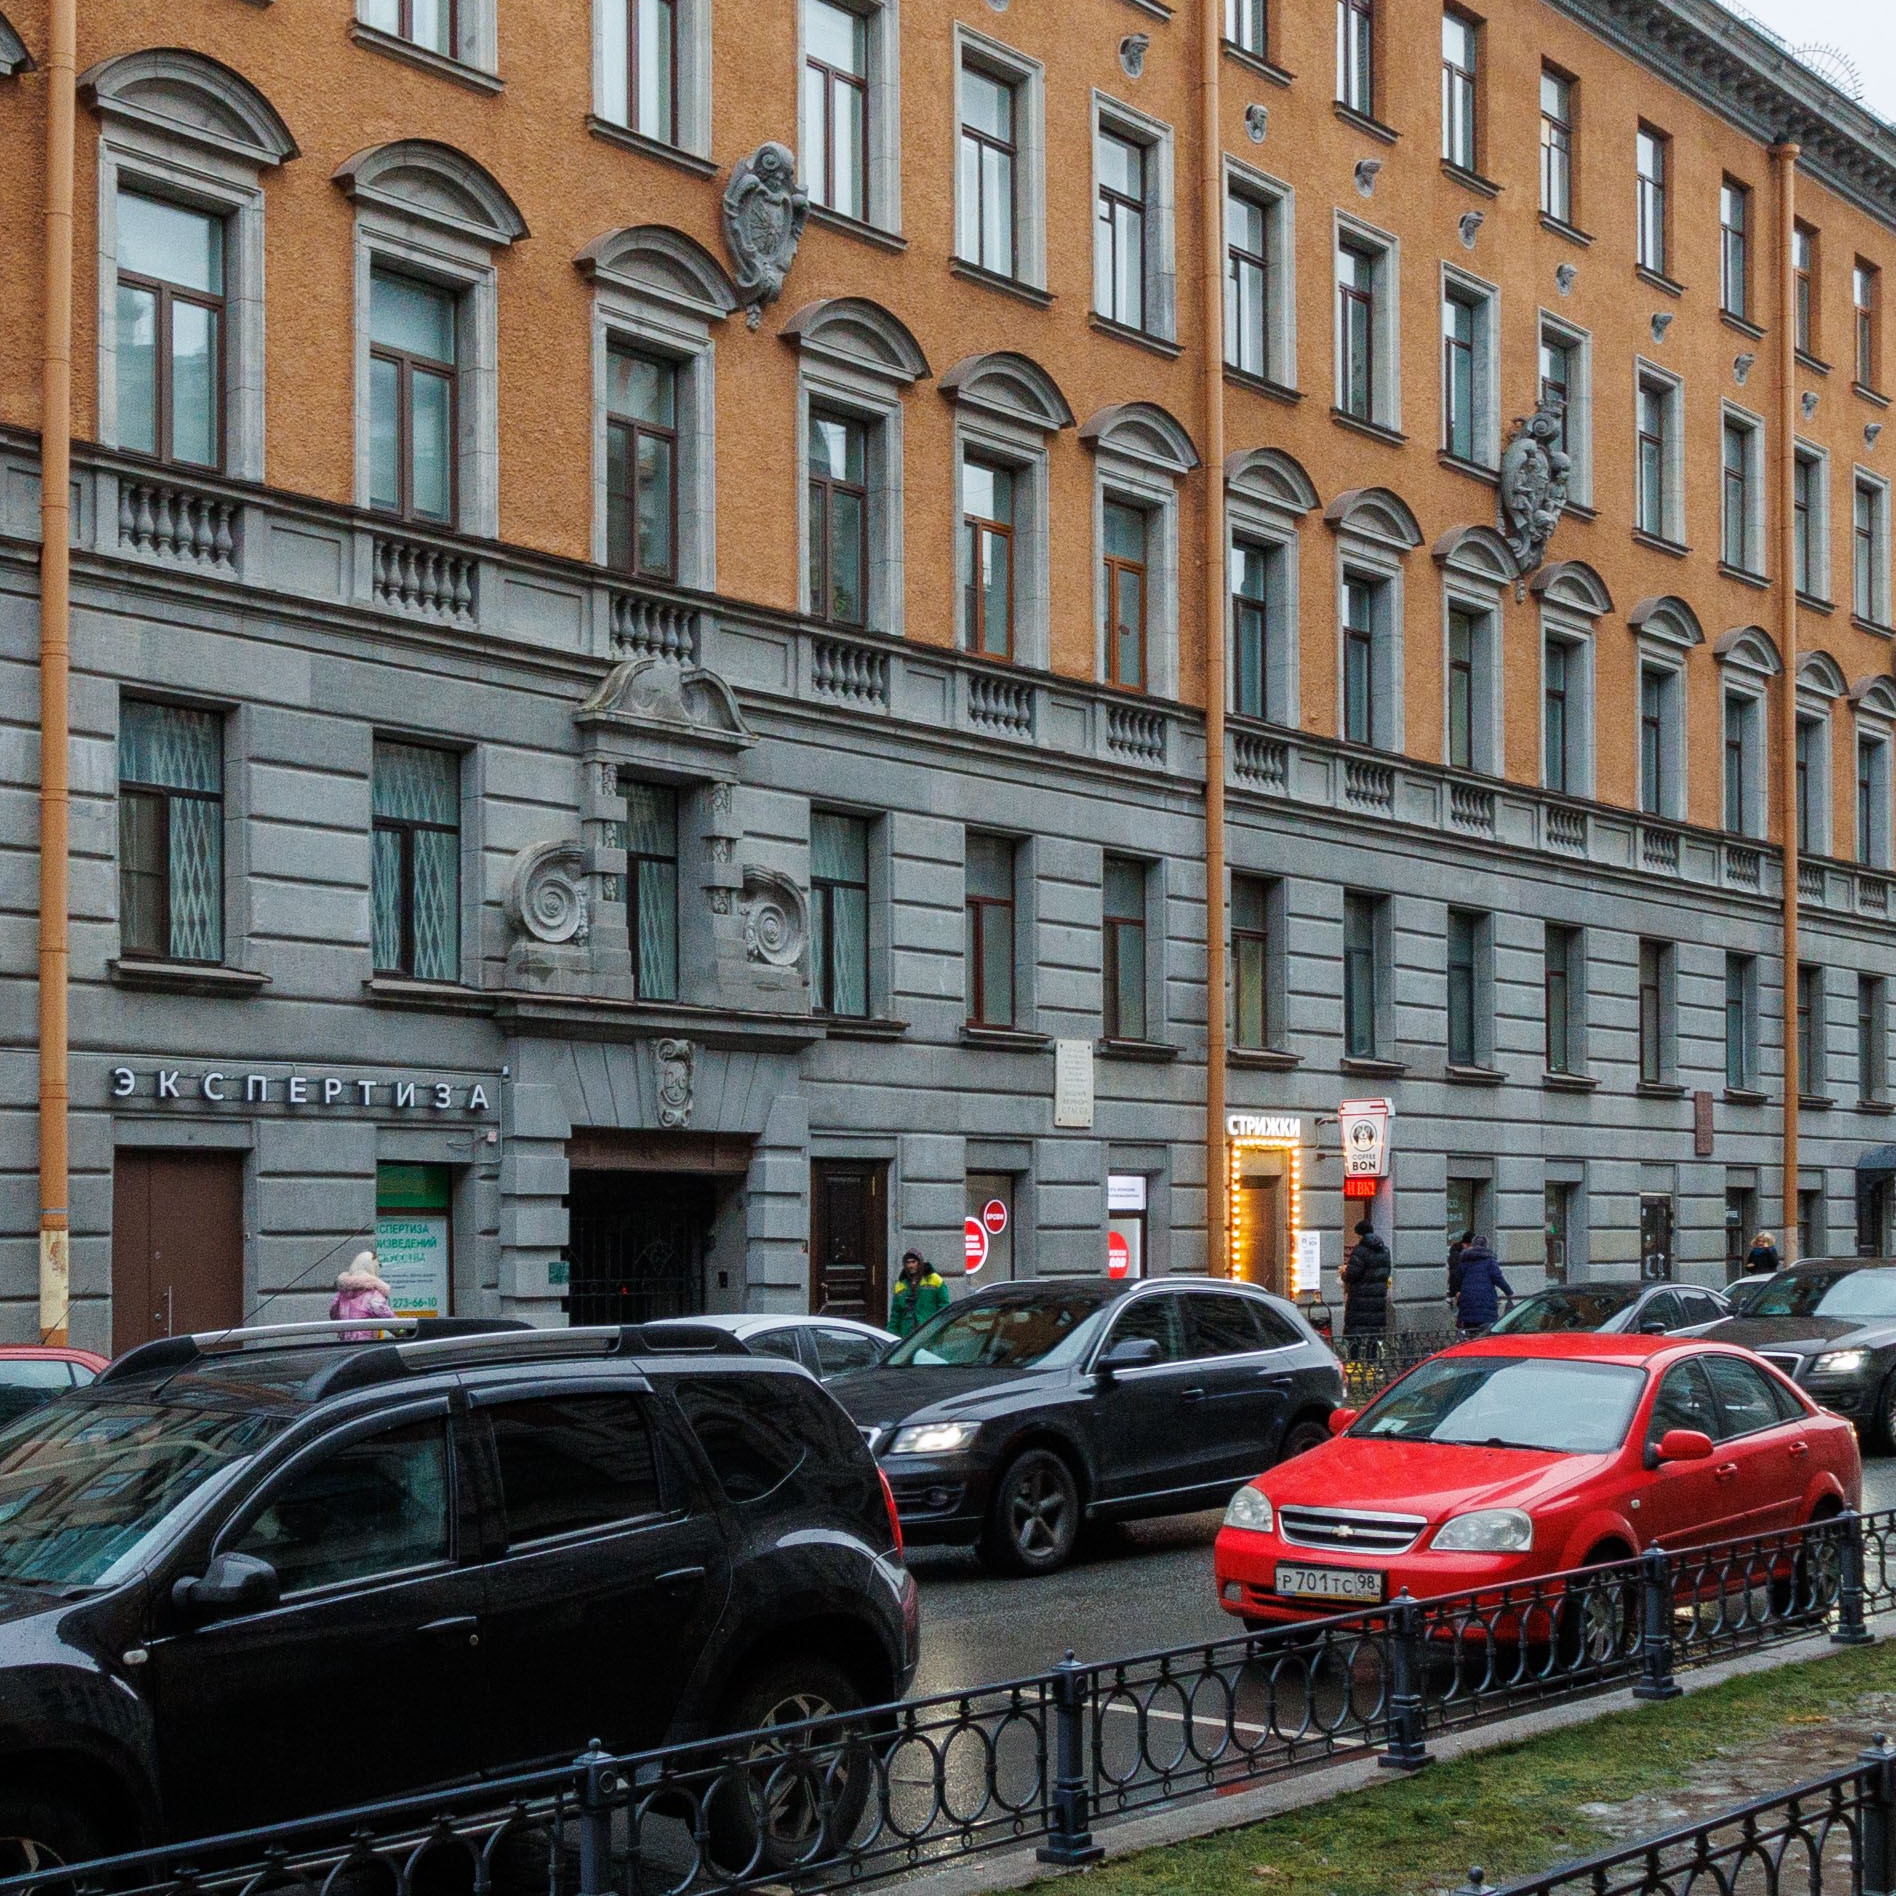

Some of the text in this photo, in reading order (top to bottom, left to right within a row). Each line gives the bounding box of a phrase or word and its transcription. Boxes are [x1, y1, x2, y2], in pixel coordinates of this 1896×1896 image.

[112, 1066, 490, 1110] ЭКСПЕРТИЗА
[1226, 1114, 1301, 1138] СТРИЖКИ
[1352, 1161, 1376, 1171] BON
